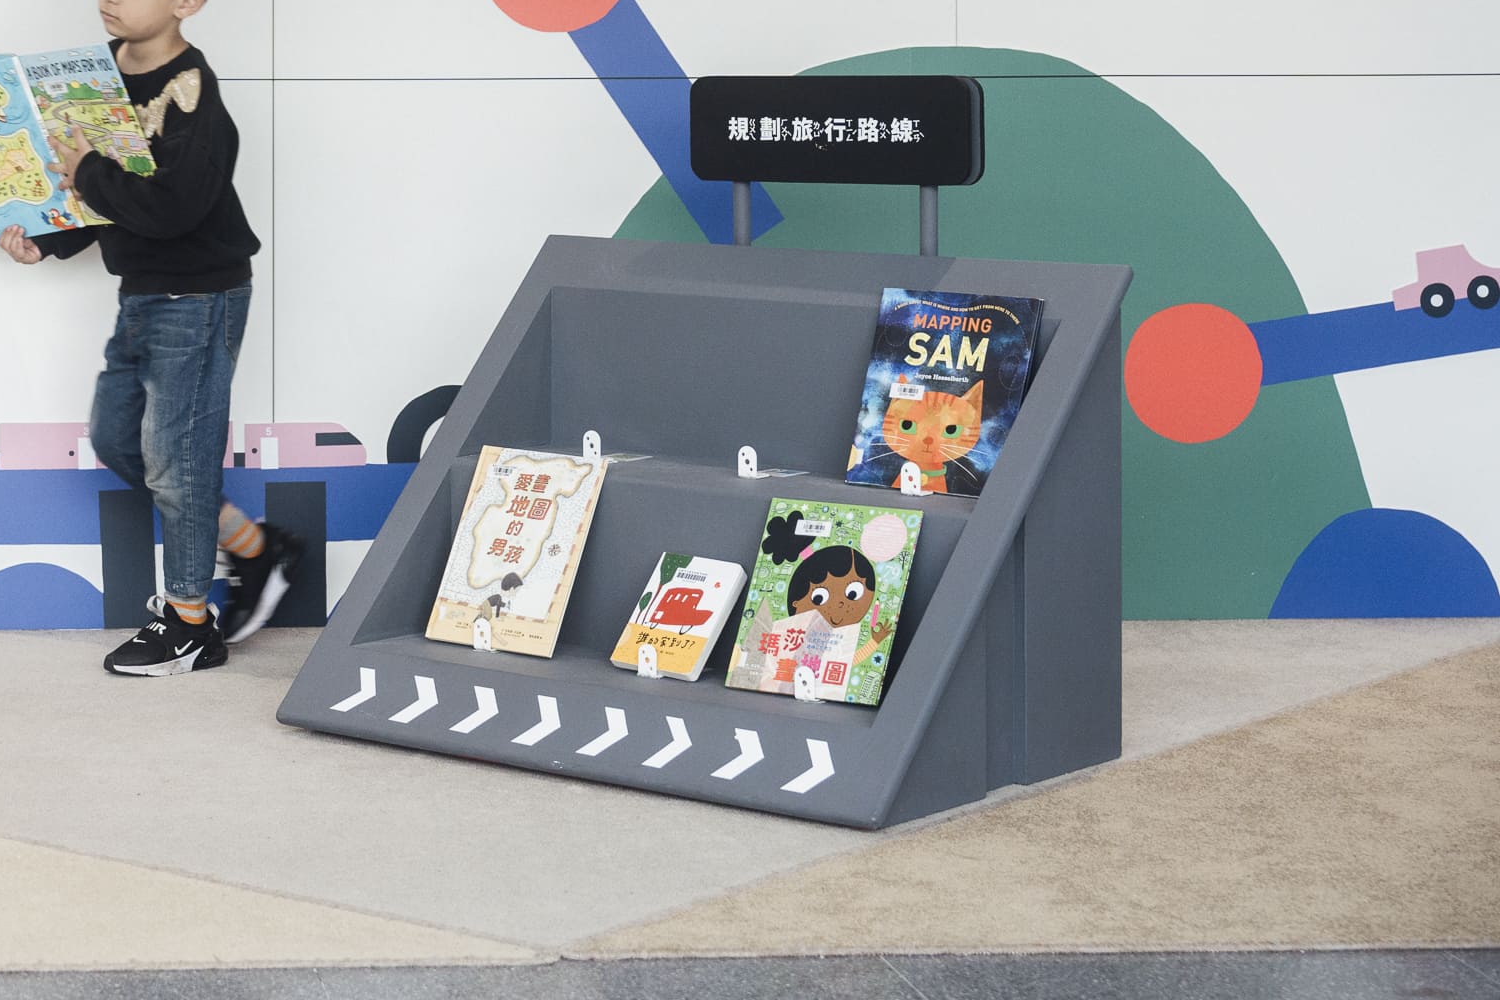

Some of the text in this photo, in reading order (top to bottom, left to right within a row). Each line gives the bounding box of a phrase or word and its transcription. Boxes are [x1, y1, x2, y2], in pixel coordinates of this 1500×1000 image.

[728, 116, 924, 143] 規劃旅行路線
[913, 313, 993, 333] MAPPING
[904, 331, 990, 372] SAM
[513, 473, 552, 494] 愛畫
[506, 494, 552, 520] 地圖
[505, 519, 524, 537] 的
[487, 538, 525, 564] 男孩
[757, 628, 806, 657] 瑪莎
